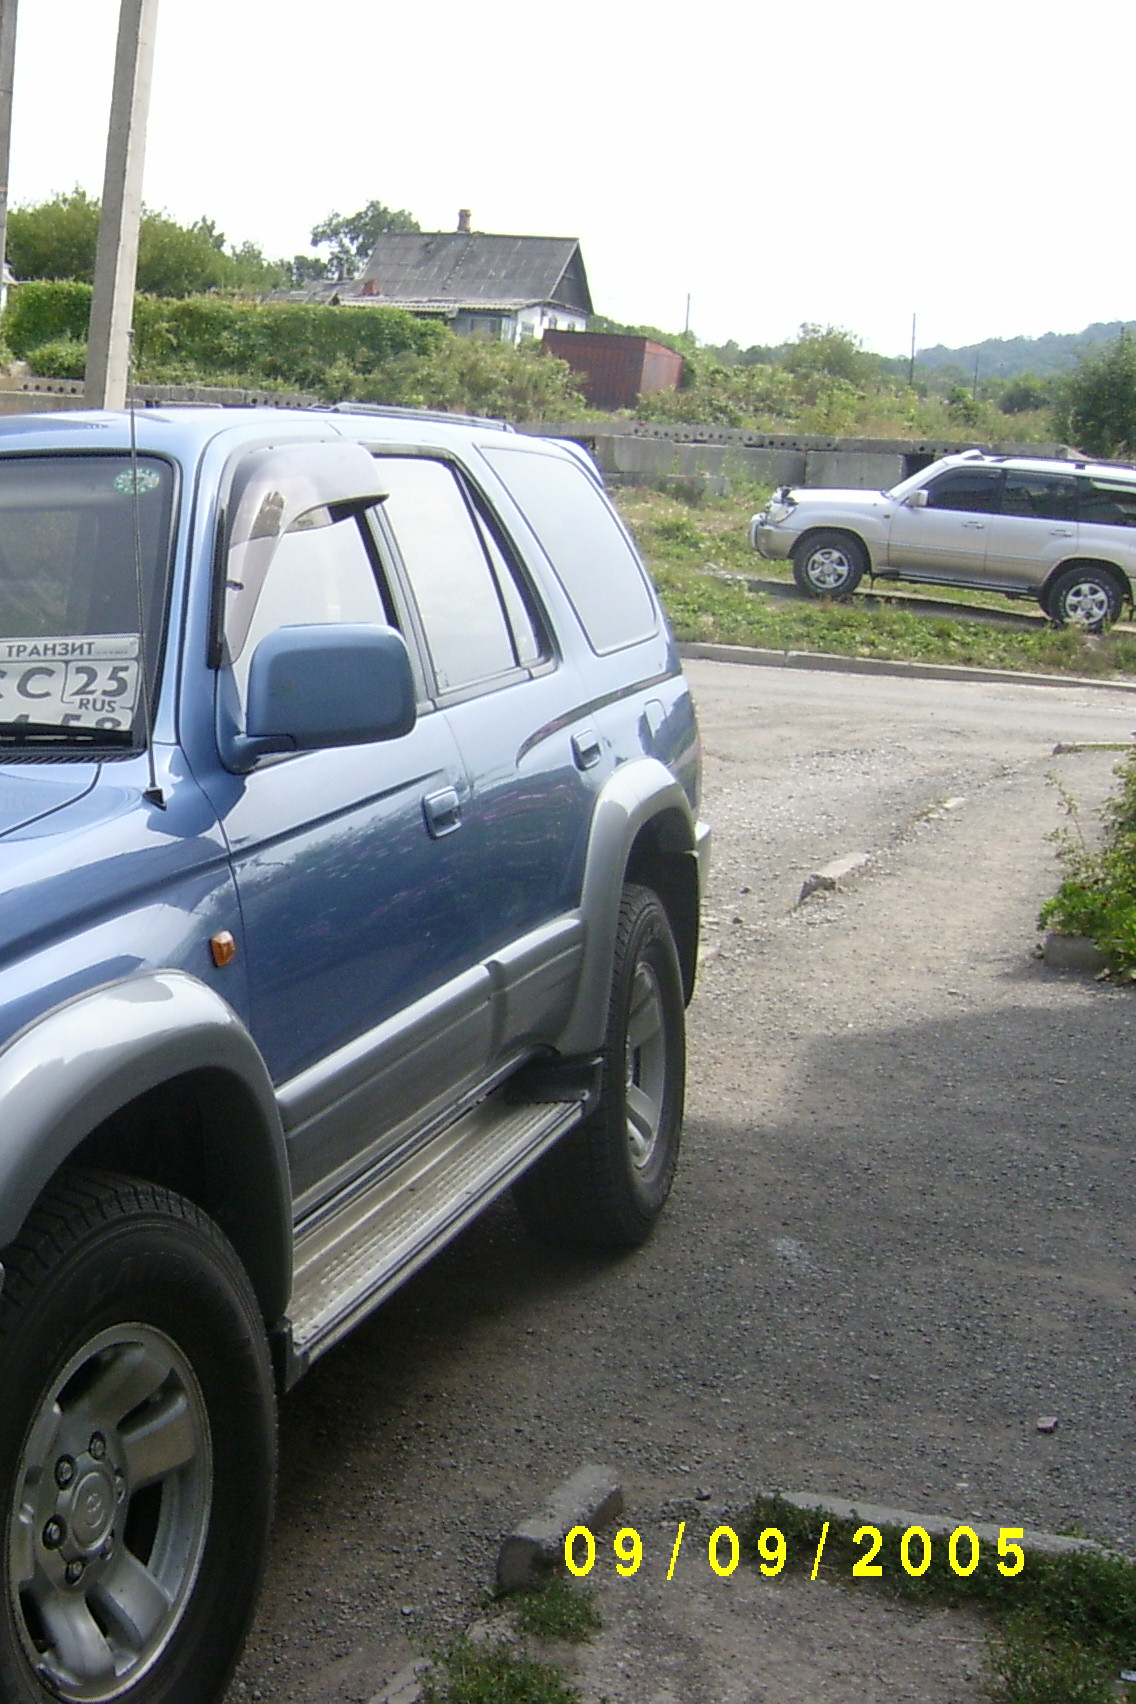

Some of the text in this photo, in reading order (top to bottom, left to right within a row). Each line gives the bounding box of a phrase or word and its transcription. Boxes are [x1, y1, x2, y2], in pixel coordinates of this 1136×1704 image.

[6, 642, 95, 658] ТРАНЗИТ
[70, 666, 129, 697] 25
[78, 697, 116, 713] RUS
